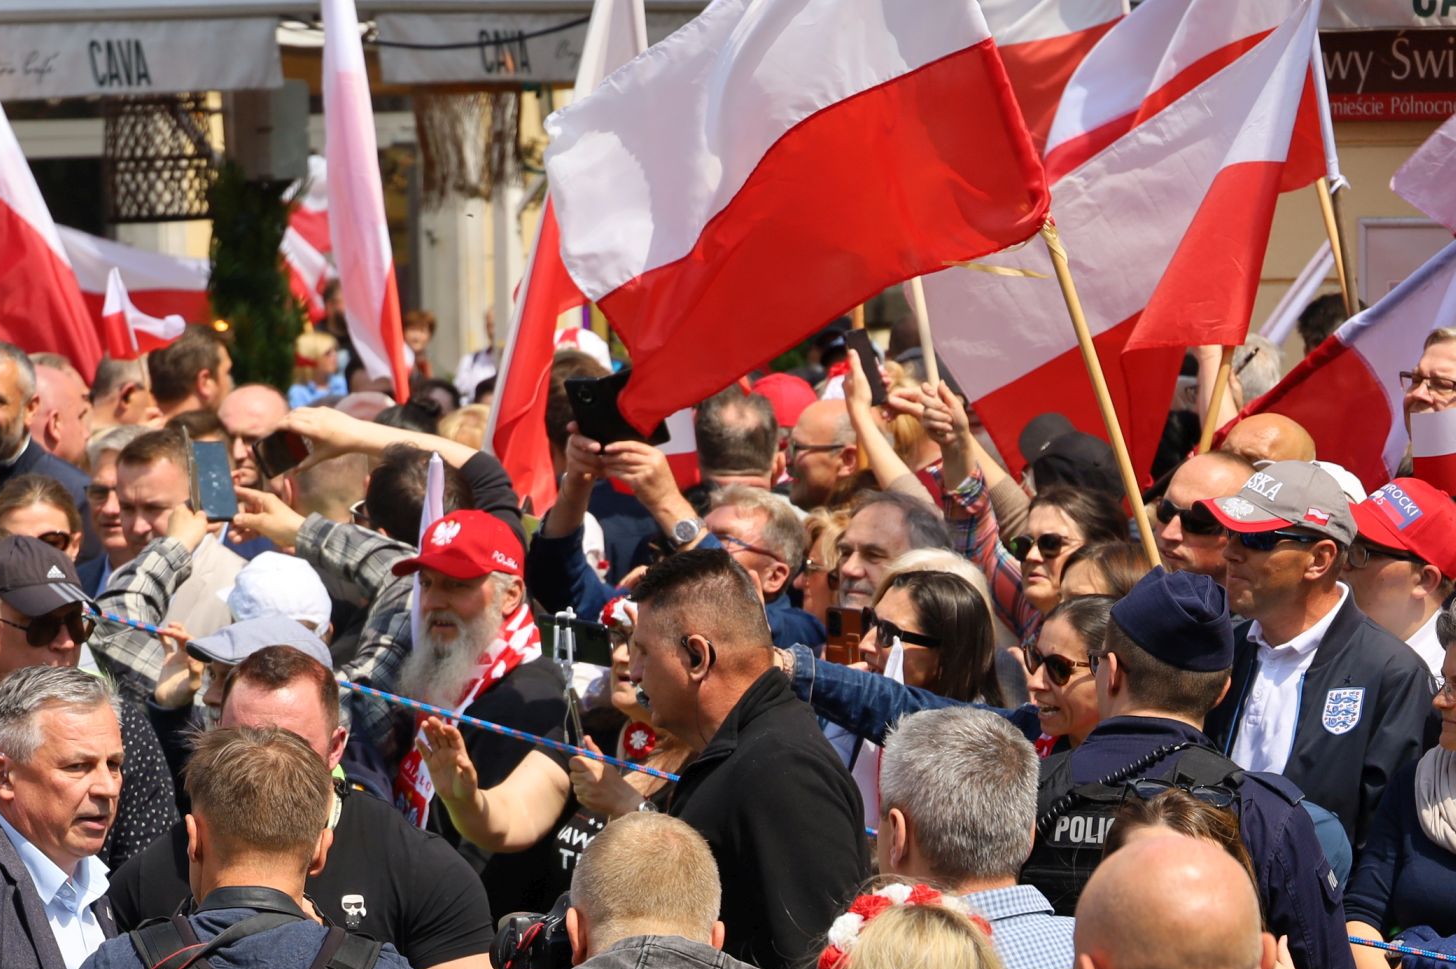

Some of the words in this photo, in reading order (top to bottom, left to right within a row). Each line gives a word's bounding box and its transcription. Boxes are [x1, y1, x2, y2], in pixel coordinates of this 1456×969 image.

[89, 38, 152, 87] CAVA
[1322, 50, 1374, 95] wy
[1391, 29, 1456, 81] Świ
[1331, 98, 1384, 115] mieście
[1241, 471, 1284, 502] SKA
[1380, 483, 1421, 517] ROCKI
[1053, 815, 1116, 844] POLI
